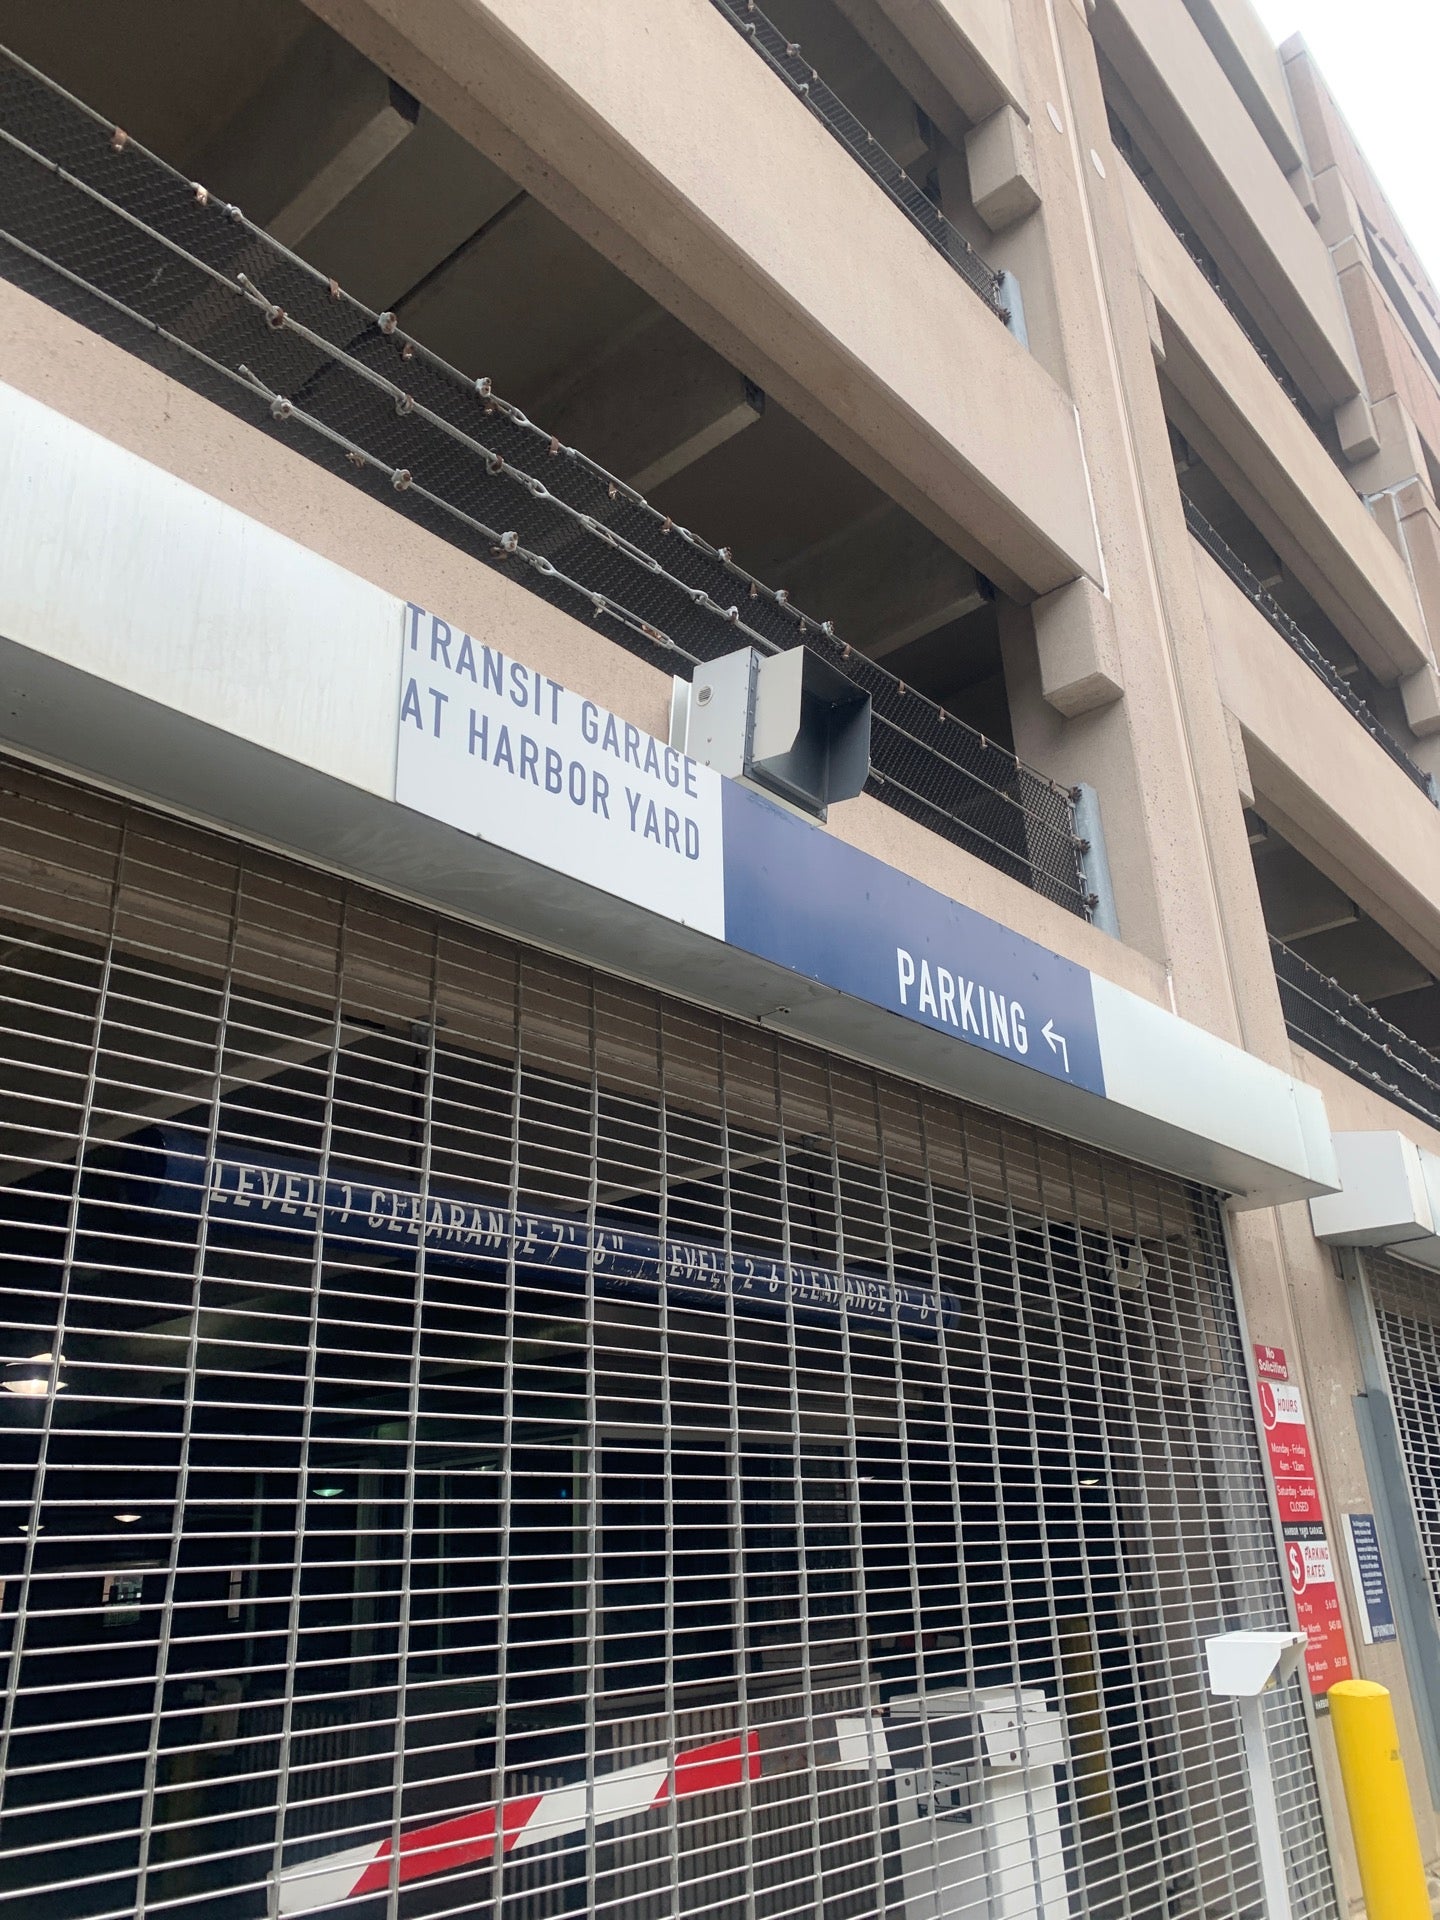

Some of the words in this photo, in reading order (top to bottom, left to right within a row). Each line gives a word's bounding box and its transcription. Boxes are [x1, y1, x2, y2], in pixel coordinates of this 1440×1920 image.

[406, 601, 564, 725] TRANSIT
[581, 700, 698, 799] GARAGE
[401, 678, 448, 738] AT
[468, 708, 610, 820] HARBOR
[624, 786, 700, 861] YARD
[897, 947, 1029, 1055] PARKING
[210, 1163, 319, 1219] LEVEL
[1265, 1347, 1275, 1359] No
[1258, 1359, 1287, 1378] Soliciting
[1277, 1398, 1298, 1413] HOURS
[1305, 1547, 1328, 1560] PARKING
[1307, 1565, 1326, 1577] RATES
